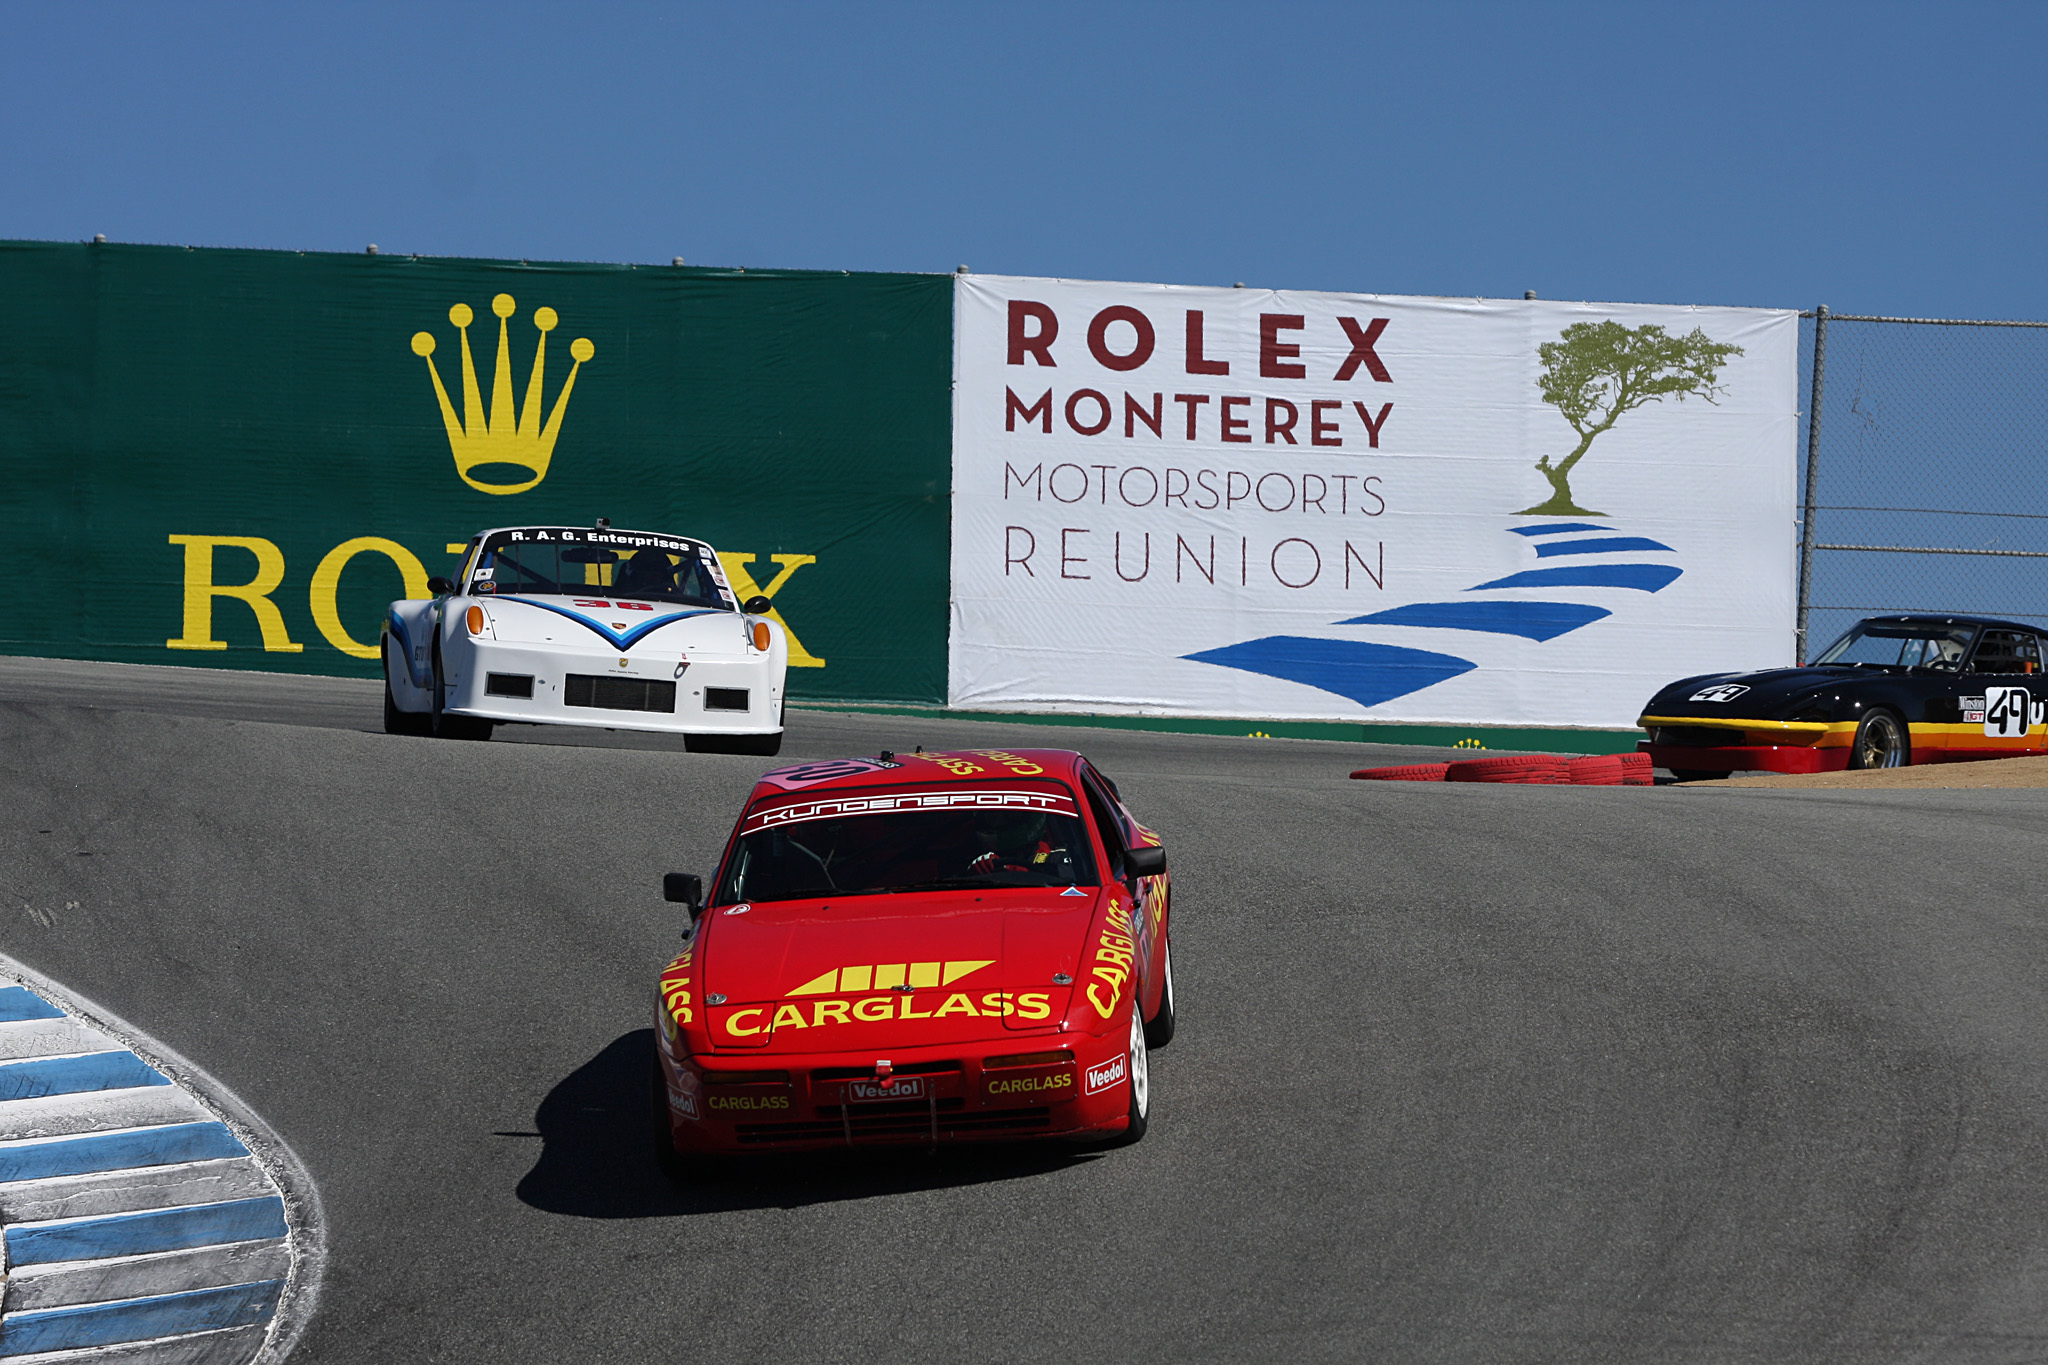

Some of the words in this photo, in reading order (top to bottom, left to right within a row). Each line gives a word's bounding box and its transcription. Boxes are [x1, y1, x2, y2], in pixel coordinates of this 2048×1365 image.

[1006, 299, 1394, 383] ROLEX
[1005, 384, 1395, 449] MONTEREY
[1004, 461, 1386, 517] MOTORSPORTS
[511, 531, 530, 541] R.
[536, 530, 556, 541] A.
[561, 531, 581, 541] G.
[587, 532, 690, 552] Enterprises
[1005, 525, 1384, 590] REUNION
[165, 533, 827, 669] ROX
[1696, 685, 1749, 701] 49
[1987, 689, 2028, 735] 49
[763, 794, 1057, 825] KUNDENSPORT
[1086, 898, 1135, 1020] CARGLASS
[726, 992, 1051, 1037] CARGLASS
[854, 1081, 918, 1098] Veedol
[988, 1073, 1072, 1094] CARGLASS
[1089, 1065, 1124, 1090] Veedol
[709, 1096, 790, 1109] CARGLASS
